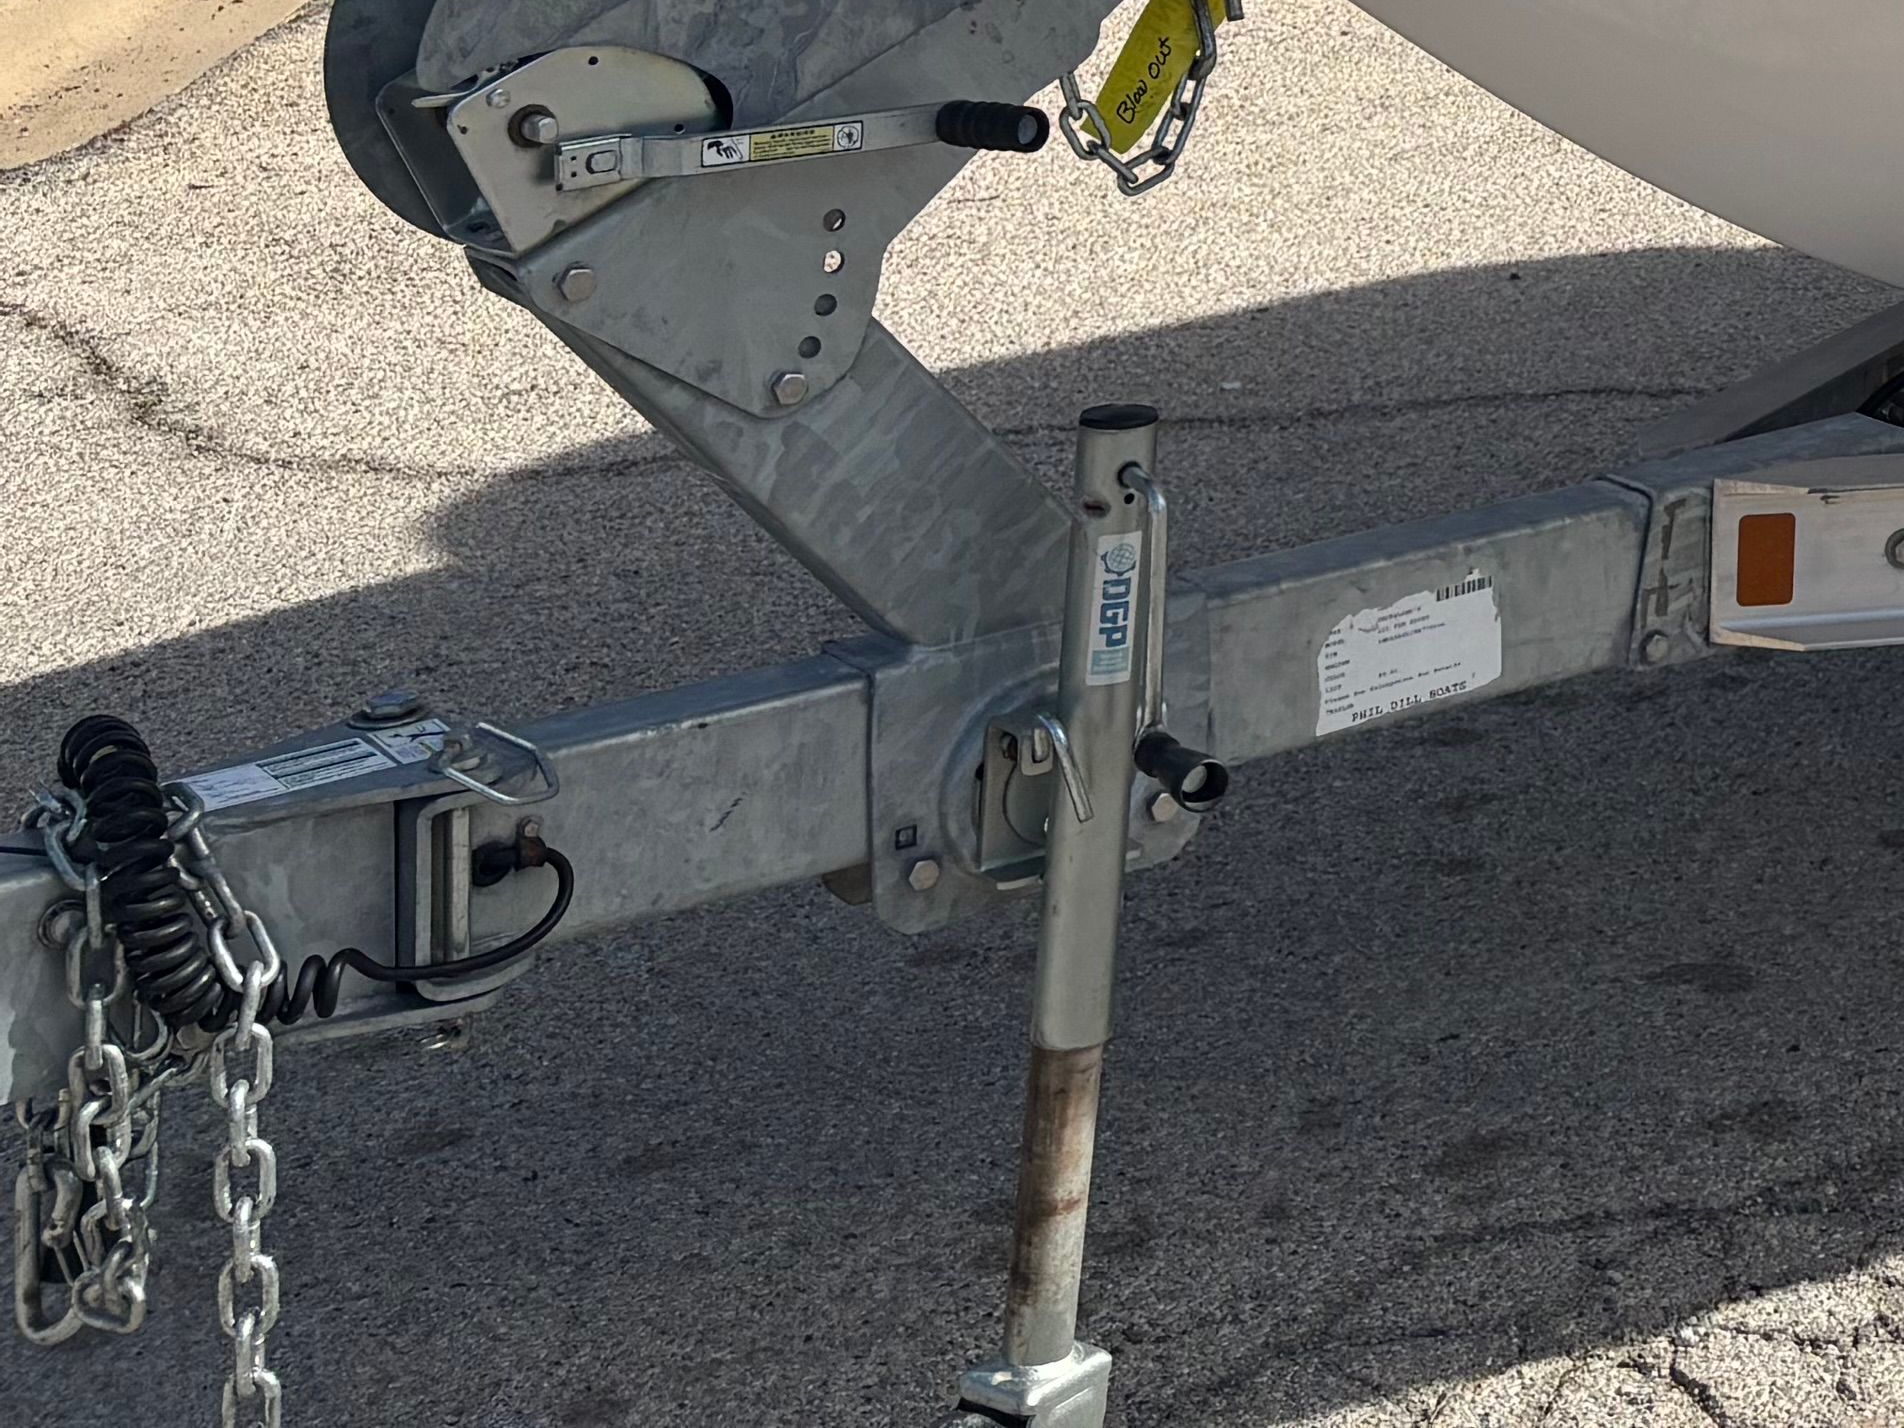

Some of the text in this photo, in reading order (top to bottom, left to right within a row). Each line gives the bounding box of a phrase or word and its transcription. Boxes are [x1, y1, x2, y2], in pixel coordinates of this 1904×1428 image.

[1098, 576, 1132, 649] DGP
[1351, 704, 1384, 723] PHIL
[1390, 694, 1422, 711] DILL
[1429, 680, 1468, 699] BOATS
